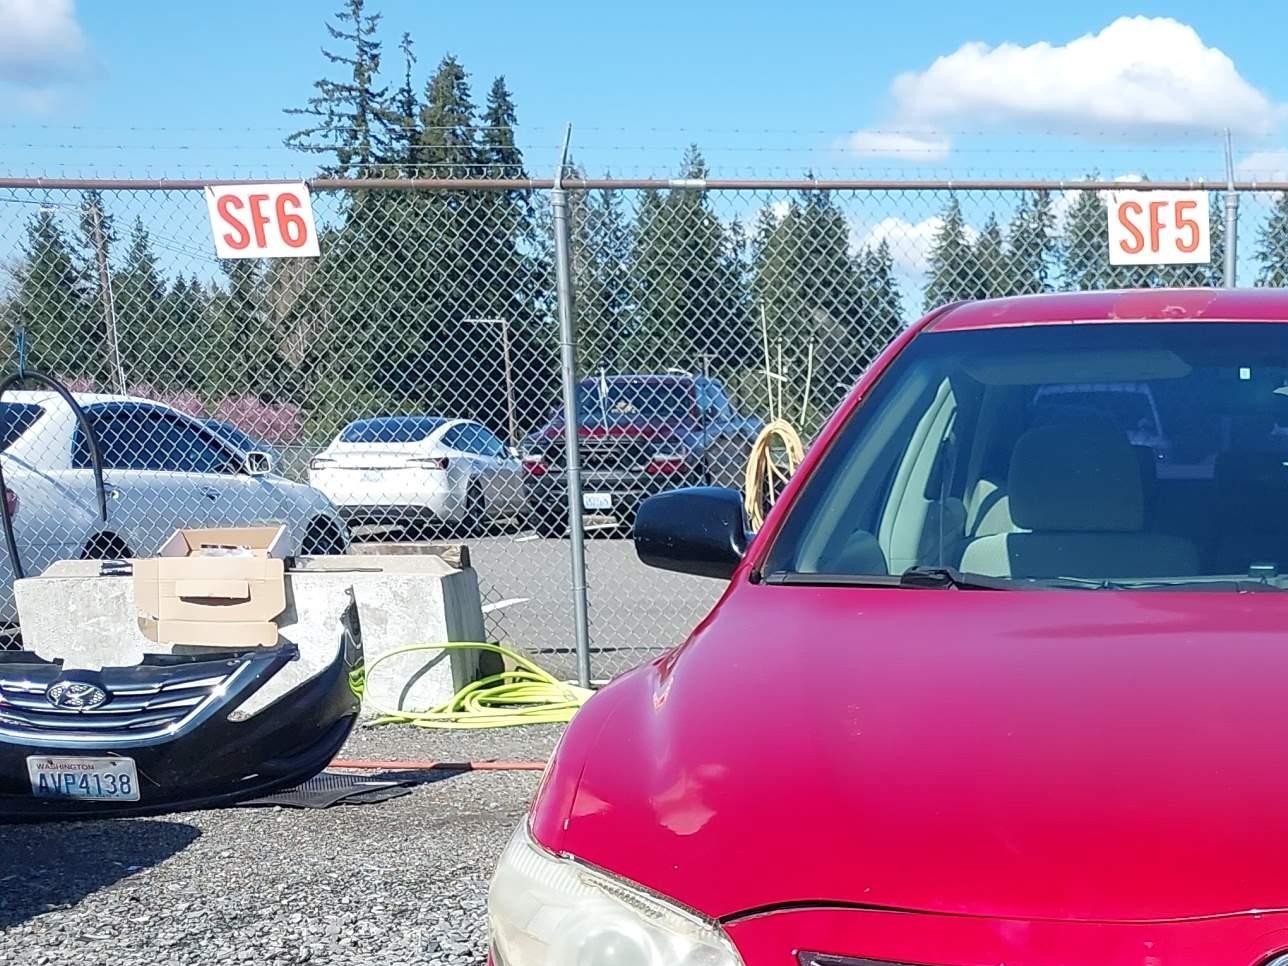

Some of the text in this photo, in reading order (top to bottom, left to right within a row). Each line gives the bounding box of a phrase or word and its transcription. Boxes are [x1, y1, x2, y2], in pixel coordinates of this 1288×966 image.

[217, 192, 308, 250] SF6
[1117, 200, 1200, 254] SF5
[36, 763, 96, 771] WASHINGTON
[38, 773, 132, 794] AVP4138
